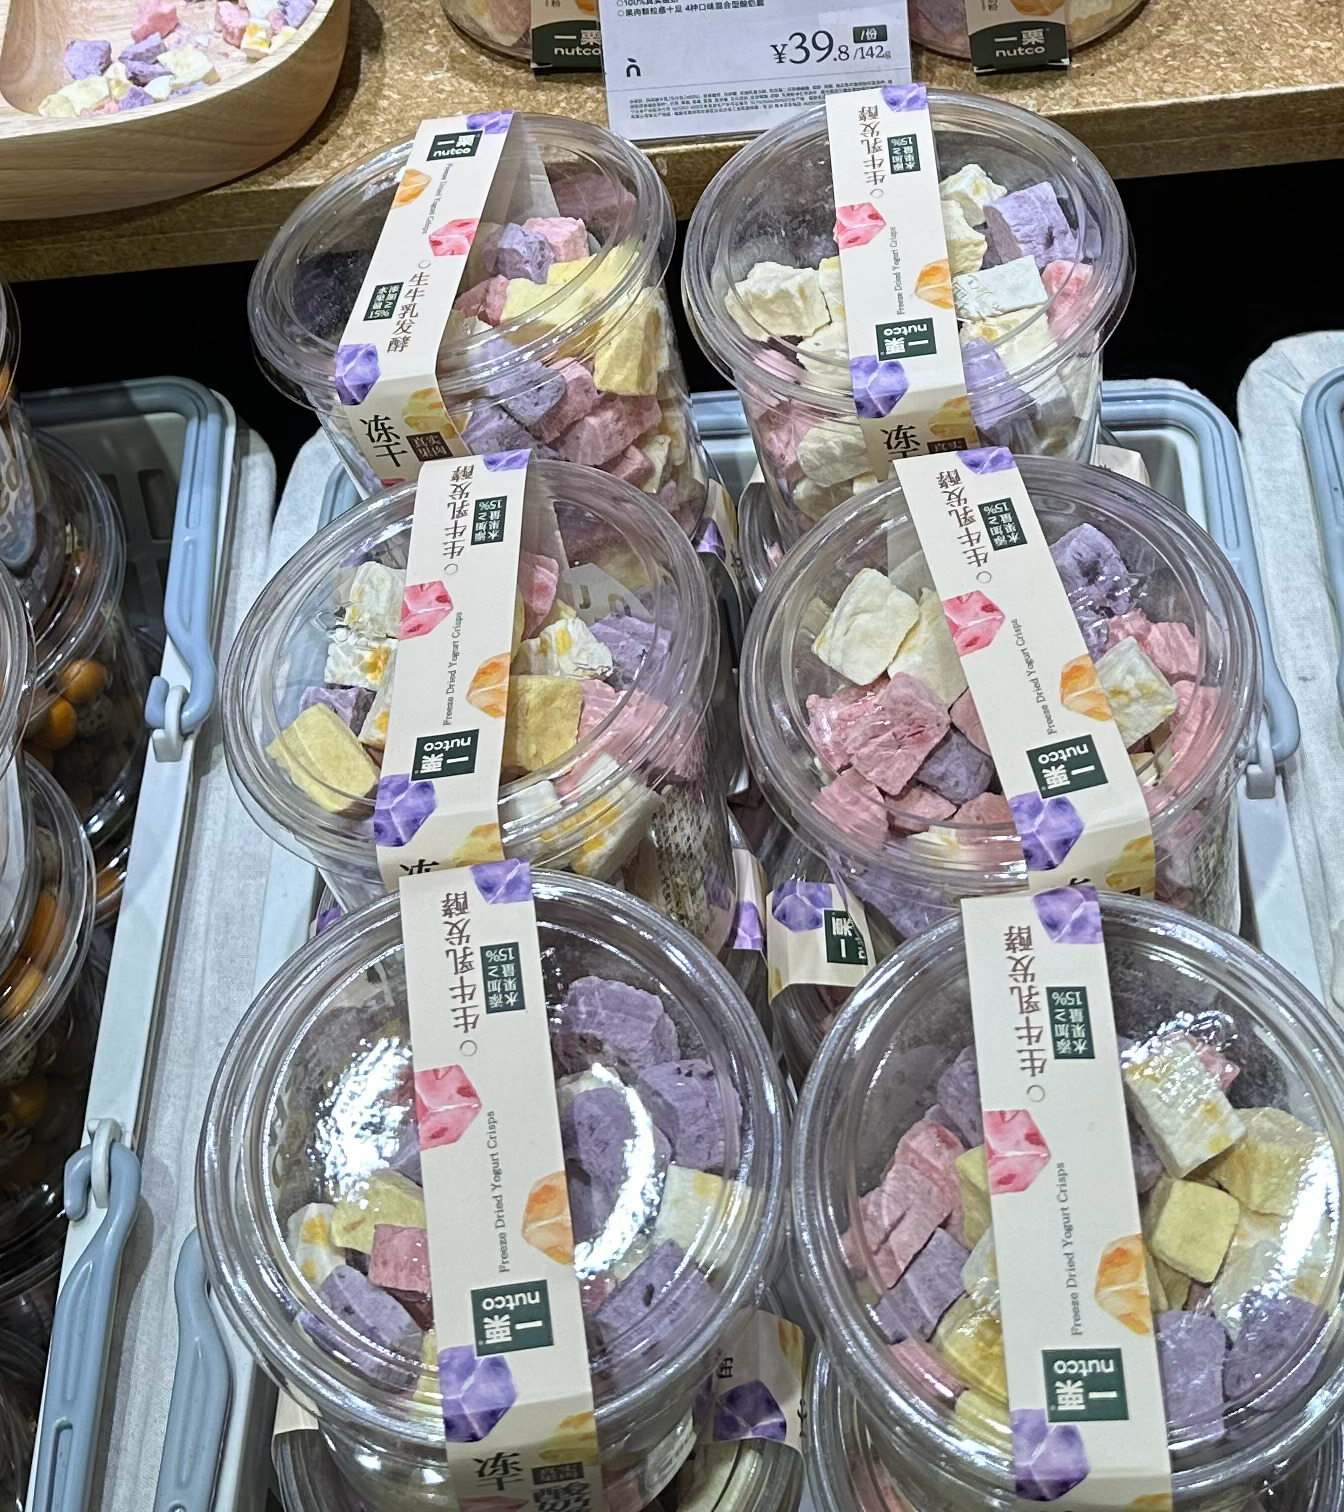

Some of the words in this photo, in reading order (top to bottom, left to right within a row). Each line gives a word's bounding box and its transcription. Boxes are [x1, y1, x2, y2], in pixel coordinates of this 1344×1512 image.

[994, 29, 1046, 47] 一栗
[994, 43, 1046, 59] nutco
[433, 147, 472, 158] nutco
[858, 104, 887, 186] 生牛乳发酵
[387, 272, 431, 354] 生牛乳发酵
[883, 324, 928, 336] nutco
[360, 414, 408, 468] 冻干
[442, 465, 474, 560] 生牛乳发酵
[936, 468, 989, 568] 生牛乳发酵
[445, 669, 456, 695] Dried
[1029, 677, 1046, 704] Dried
[423, 737, 472, 751] nutco
[1037, 742, 1090, 765] nutco
[441, 891, 481, 1034] 生牛乳发酵
[1003, 925, 1048, 1078] 生牛乳发酵
[485, 1110, 498, 1149] Crisps
[489, 1151, 502, 1193] Yogurt
[1056, 1161, 1069, 1204] Crisps
[491, 1193, 506, 1230] Dried
[1060, 1206, 1074, 1249] Yogurt
[498, 1231, 510, 1273] Freeze
[1063, 1251, 1078, 1289] Dried
[482, 1294, 541, 1313] nutco
[1070, 1291, 1083, 1337] Freeze
[484, 1314, 544, 1345] 一栗
[1053, 1356, 1116, 1375] nutco
[1055, 1376, 1118, 1410] 一栗
[472, 1451, 525, 1492] 冻干
